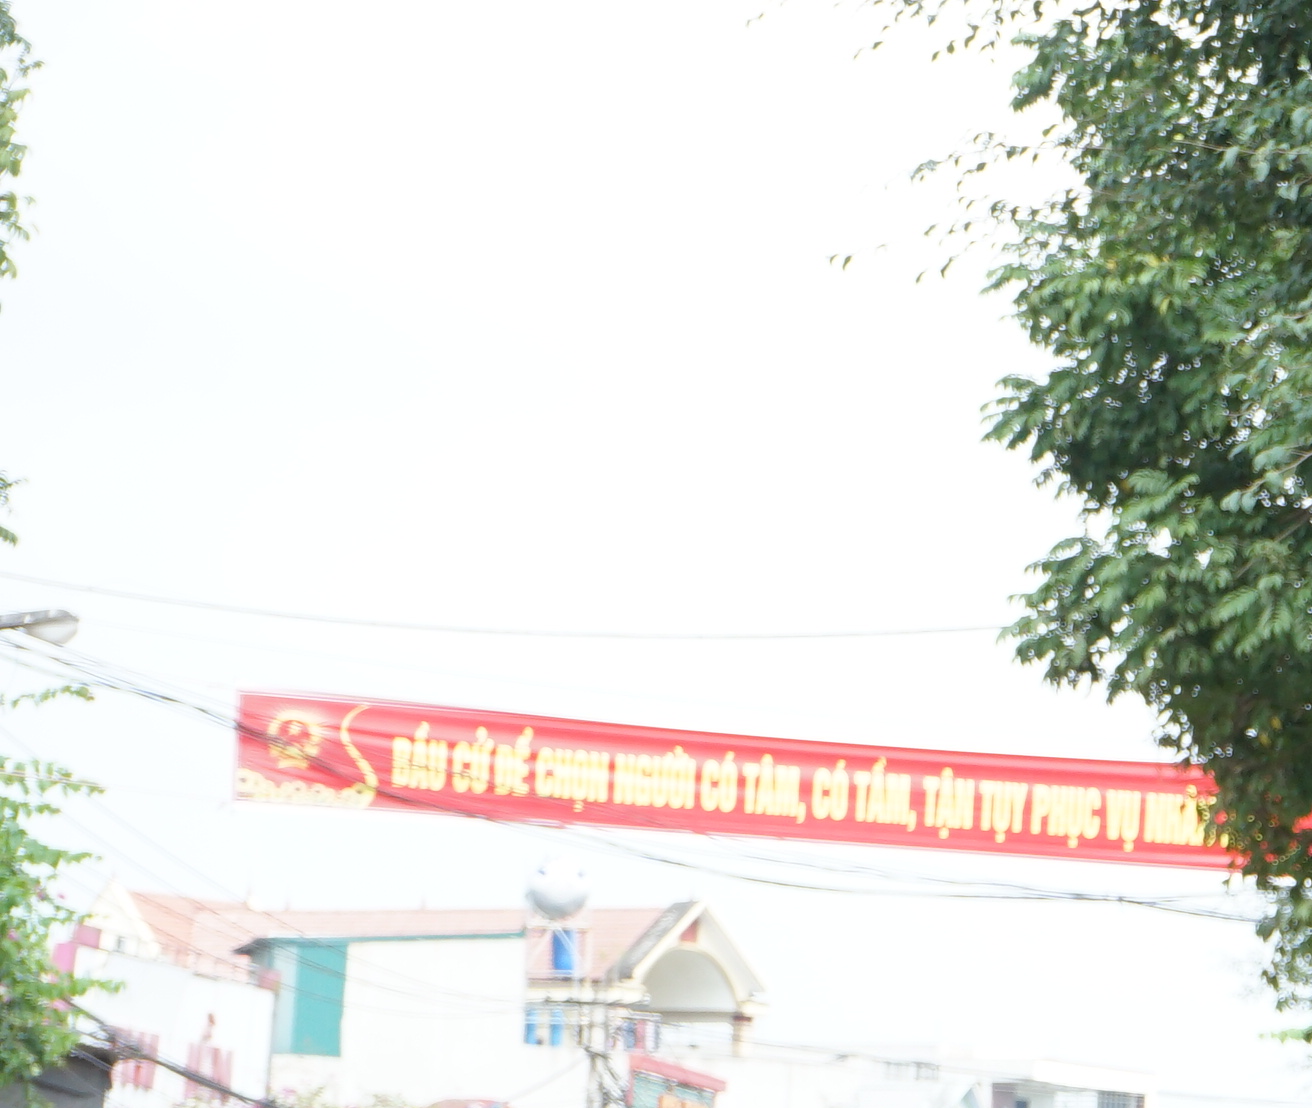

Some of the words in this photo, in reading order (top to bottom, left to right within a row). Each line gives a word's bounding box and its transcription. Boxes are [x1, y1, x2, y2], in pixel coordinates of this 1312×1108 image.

[700, 751, 739, 814] CÓ
[811, 759, 849, 821] CÓ
[922, 767, 975, 839] TẬN
[1030, 782, 1101, 849] PHỤC
[1105, 788, 1142, 852] VỤ
